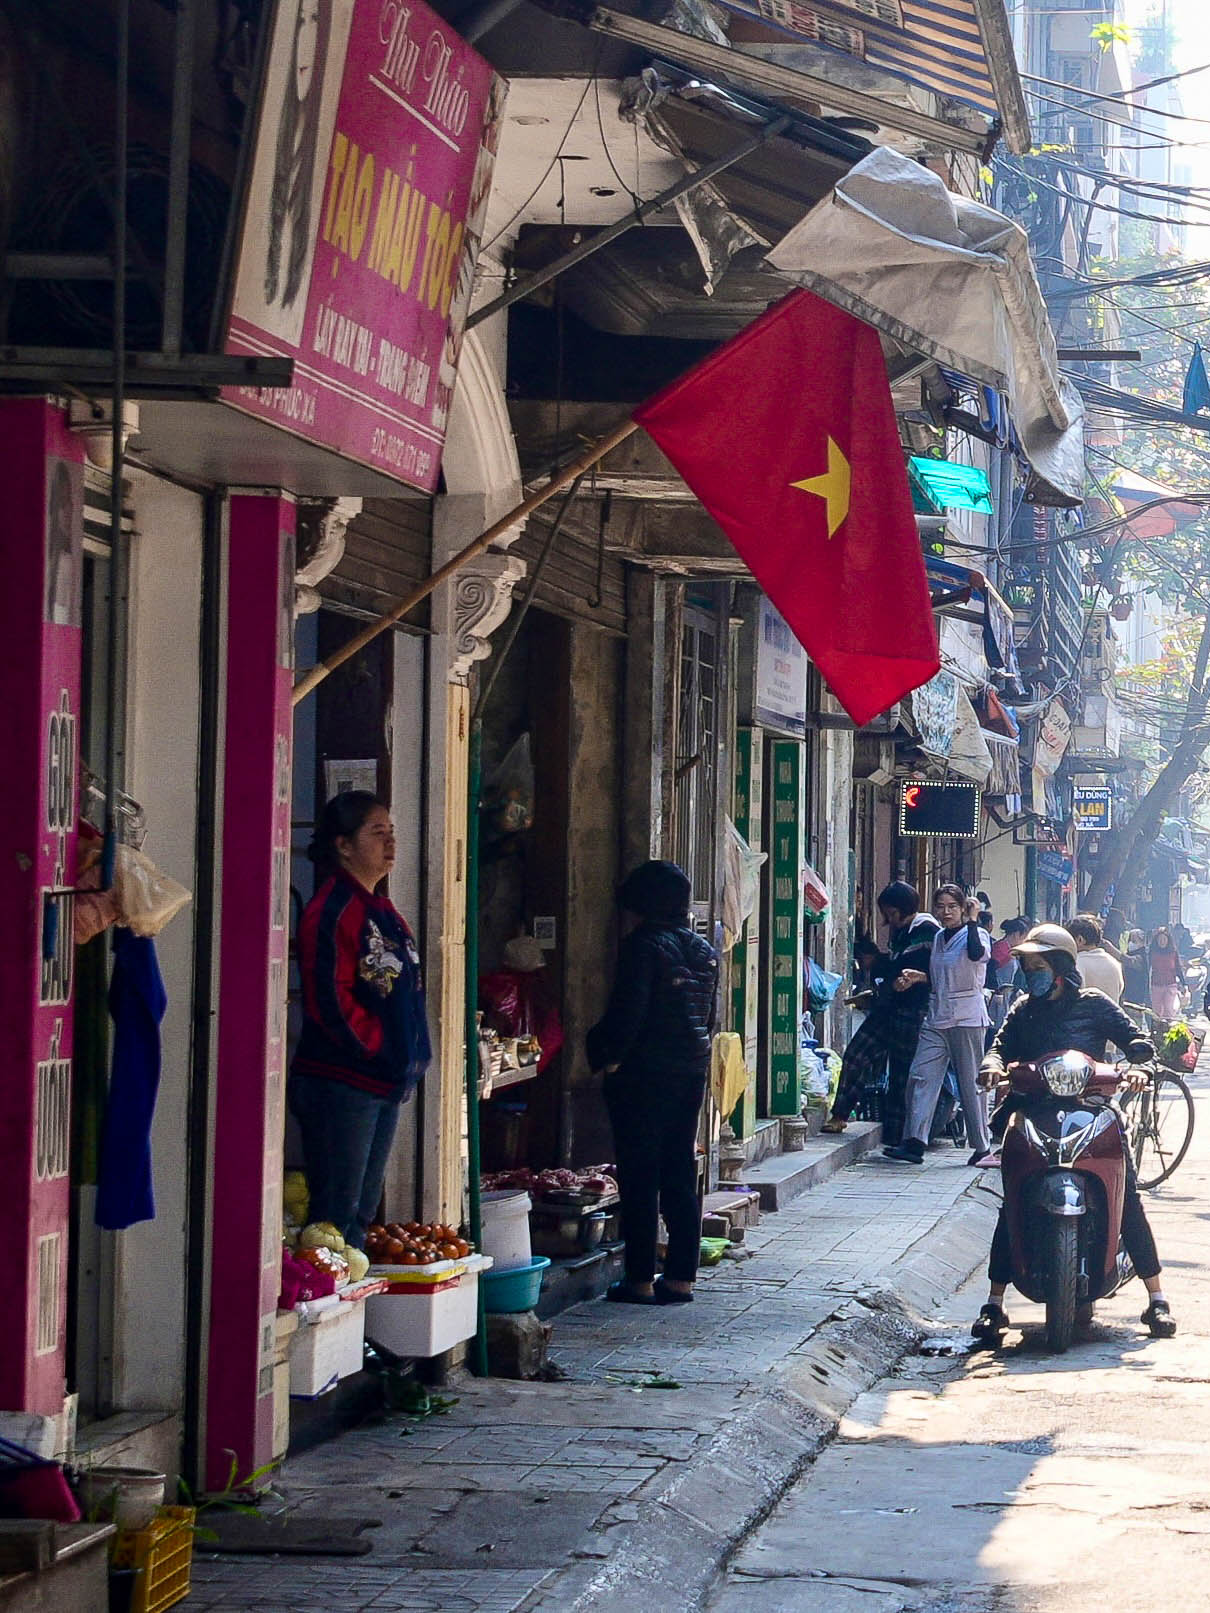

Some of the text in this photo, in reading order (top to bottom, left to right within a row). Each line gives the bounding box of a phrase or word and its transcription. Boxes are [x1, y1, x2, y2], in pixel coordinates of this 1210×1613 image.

[379, 1, 420, 95] Thu
[1086, 790, 1108, 800] DÙNG
[1080, 802, 1105, 816] LAN
